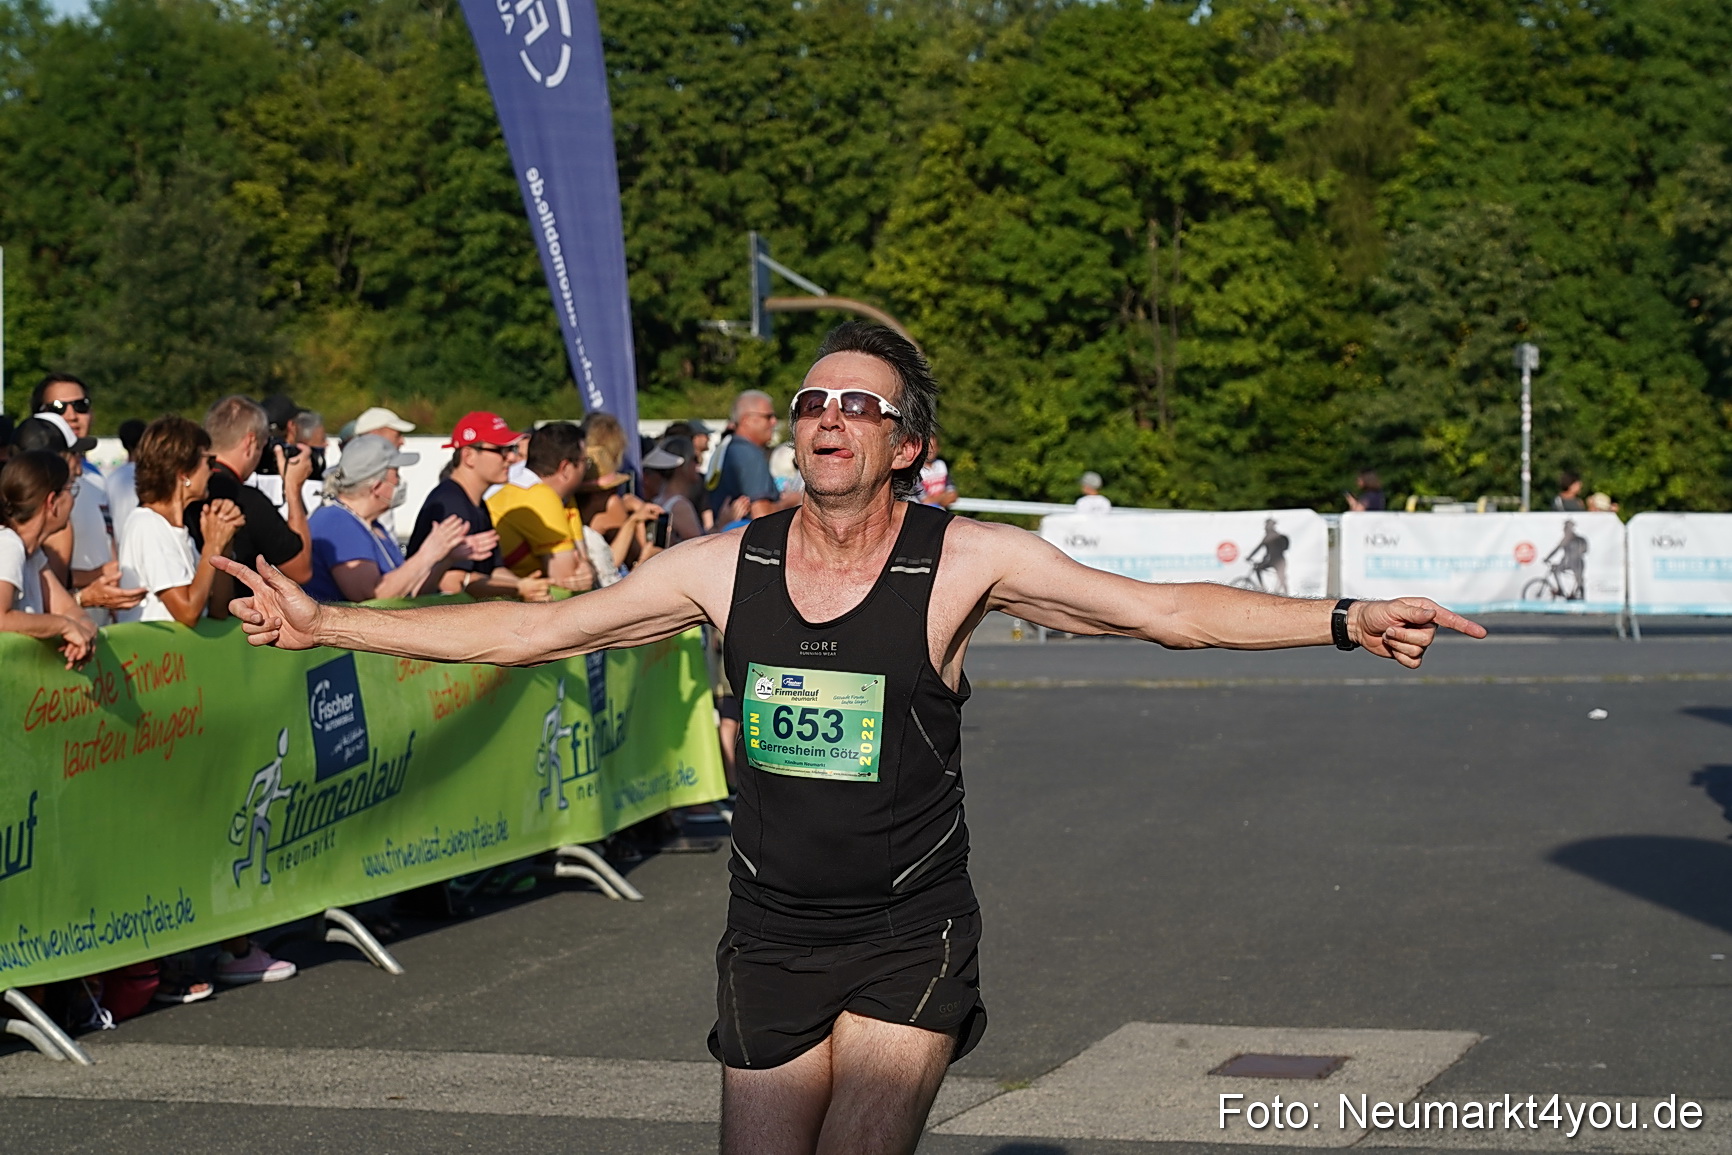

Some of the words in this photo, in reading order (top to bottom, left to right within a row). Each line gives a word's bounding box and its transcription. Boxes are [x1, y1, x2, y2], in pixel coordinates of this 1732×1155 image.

[800, 641, 838, 651] GORE
[24, 659, 119, 732] Gesunde
[121, 652, 187, 700] Firmen
[317, 693, 354, 722] Fischer
[774, 688, 819, 697] Firmenlauf
[63, 719, 128, 780] laufen
[133, 687, 204, 761] länger!
[750, 712, 760, 748] RUN
[773, 705, 844, 743] 653
[860, 717, 875, 766] 2022
[760, 740, 826, 758] Gerresheim
[830, 747, 859, 760] Götz
[784, 759, 804, 767] Klinikum
[279, 730, 416, 846] firmenlauf
[0, 790, 38, 878] uf
[277, 828, 335, 873] neumarkt
